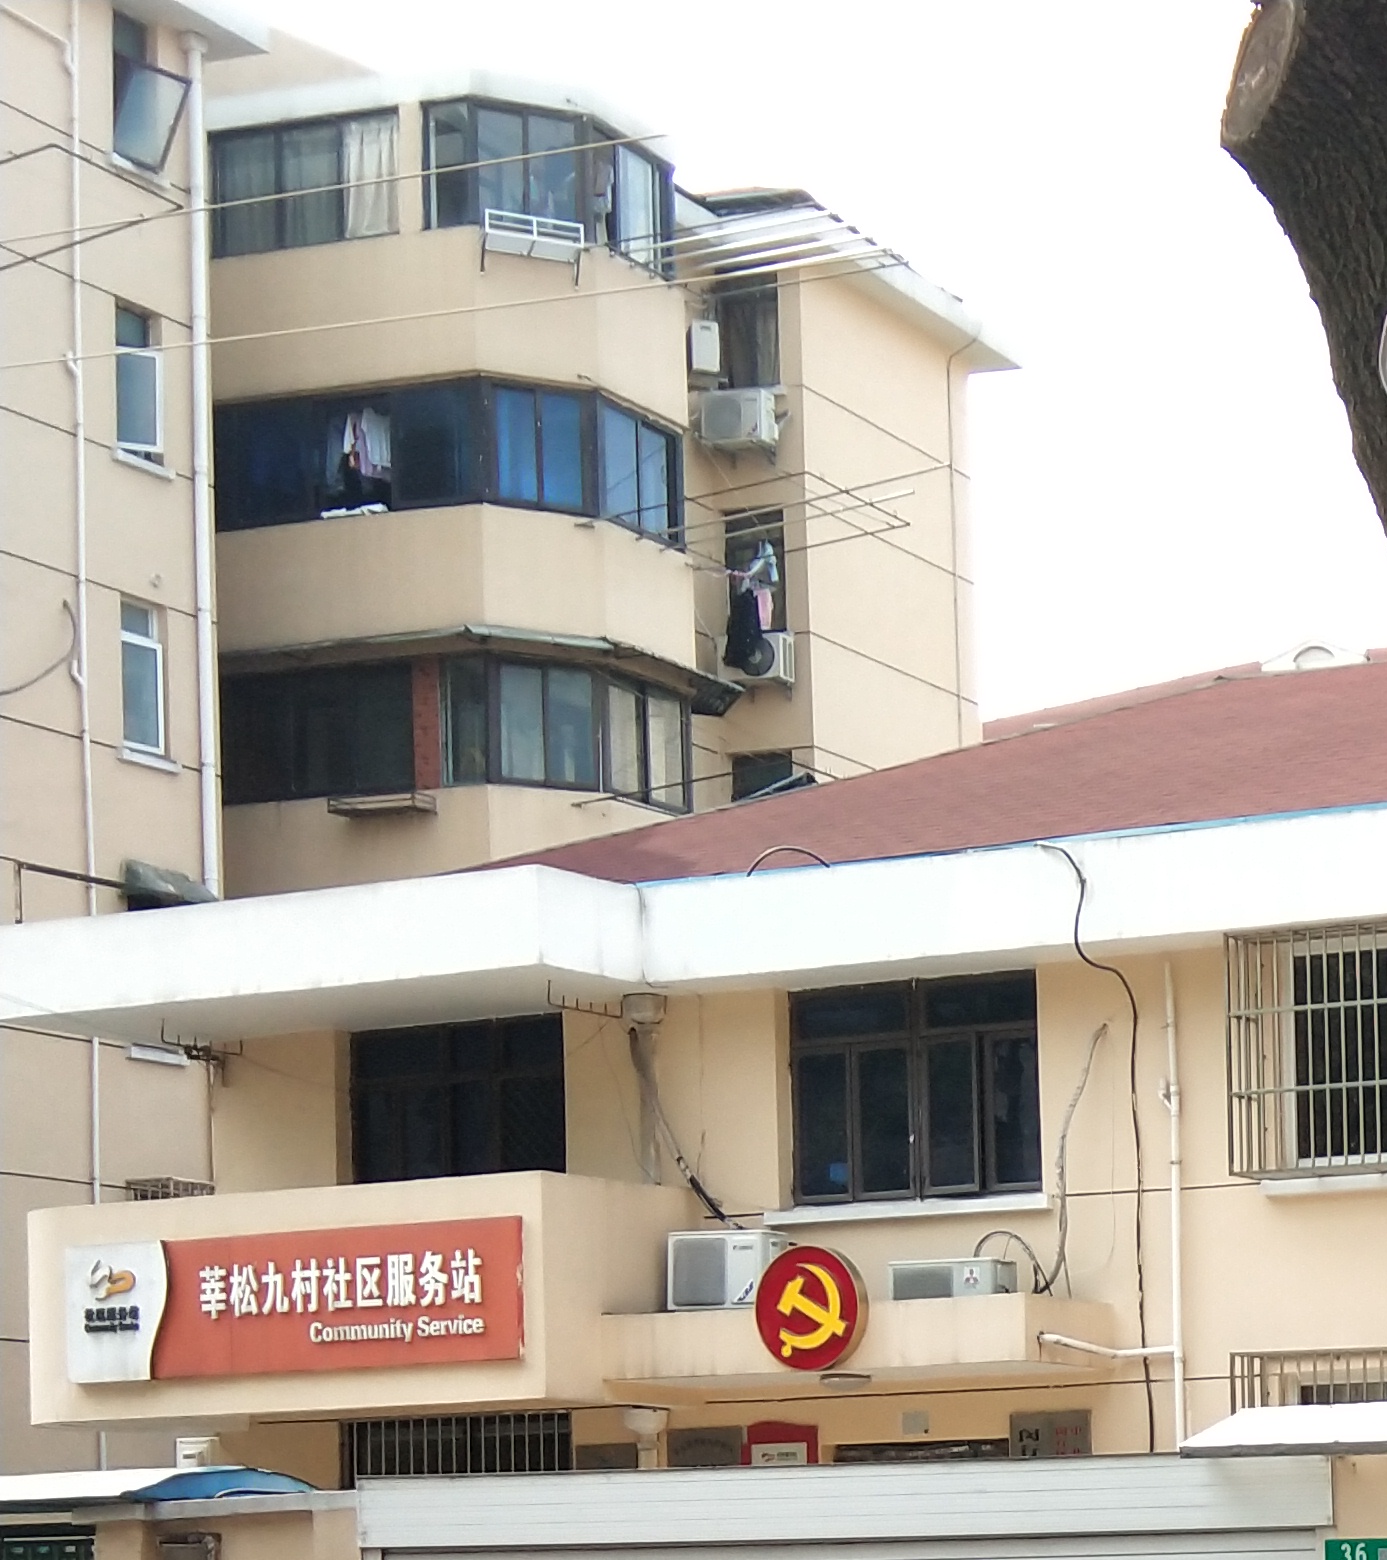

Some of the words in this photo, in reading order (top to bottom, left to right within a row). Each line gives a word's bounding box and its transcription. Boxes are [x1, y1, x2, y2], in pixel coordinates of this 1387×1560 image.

[199, 1248, 483, 1320] 莘松九村社区服务站
[309, 1317, 414, 1343] Community
[416, 1314, 485, 1338] Service
